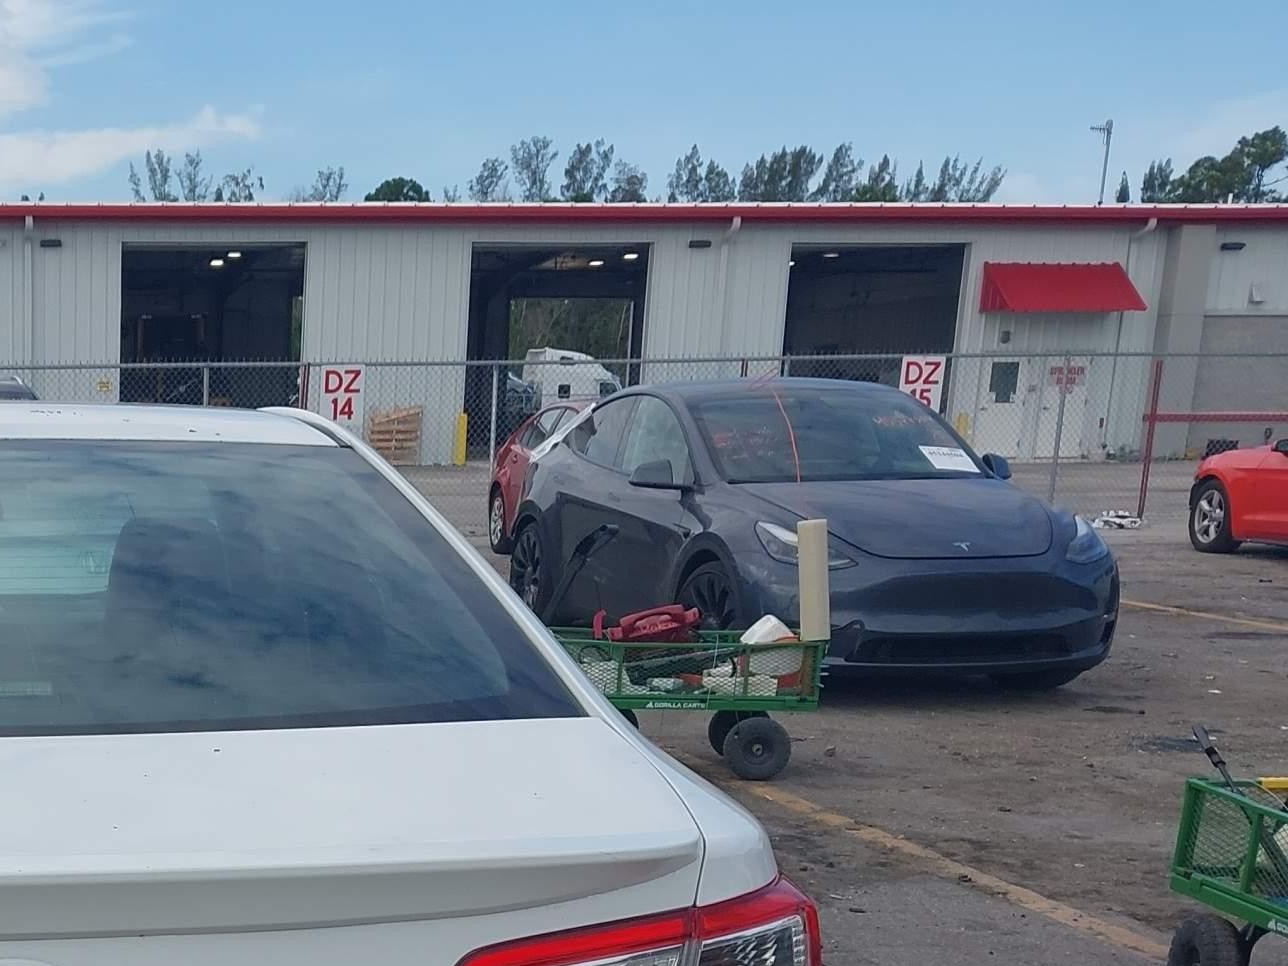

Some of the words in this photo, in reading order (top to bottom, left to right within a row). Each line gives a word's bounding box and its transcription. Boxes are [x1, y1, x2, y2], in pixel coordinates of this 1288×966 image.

[324, 369, 361, 393] DZ
[904, 361, 941, 385] DZ
[331, 397, 354, 420] 14
